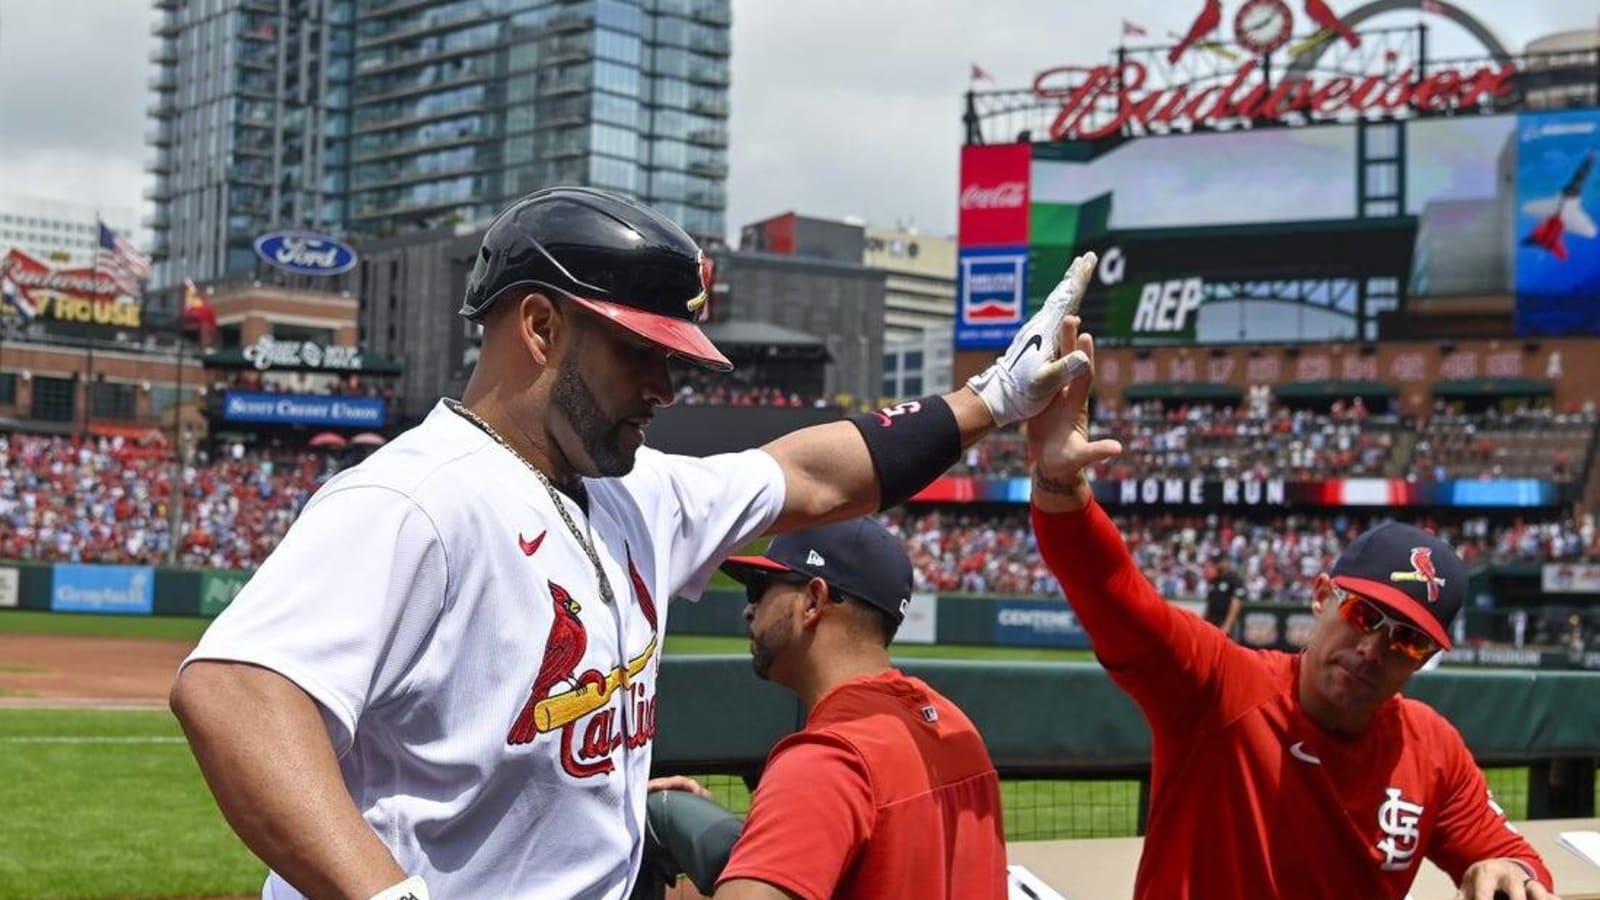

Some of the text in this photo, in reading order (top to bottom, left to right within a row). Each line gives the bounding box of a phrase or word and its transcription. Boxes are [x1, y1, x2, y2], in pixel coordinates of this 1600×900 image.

[1033, 52, 1517, 141] Budweiser
[276, 236, 339, 269] Ford
[53, 297, 140, 328] HOUSE
[1132, 277, 1204, 331] REP
[881, 400, 922, 418] 5
[1120, 477, 1286, 505] HOME RUN
